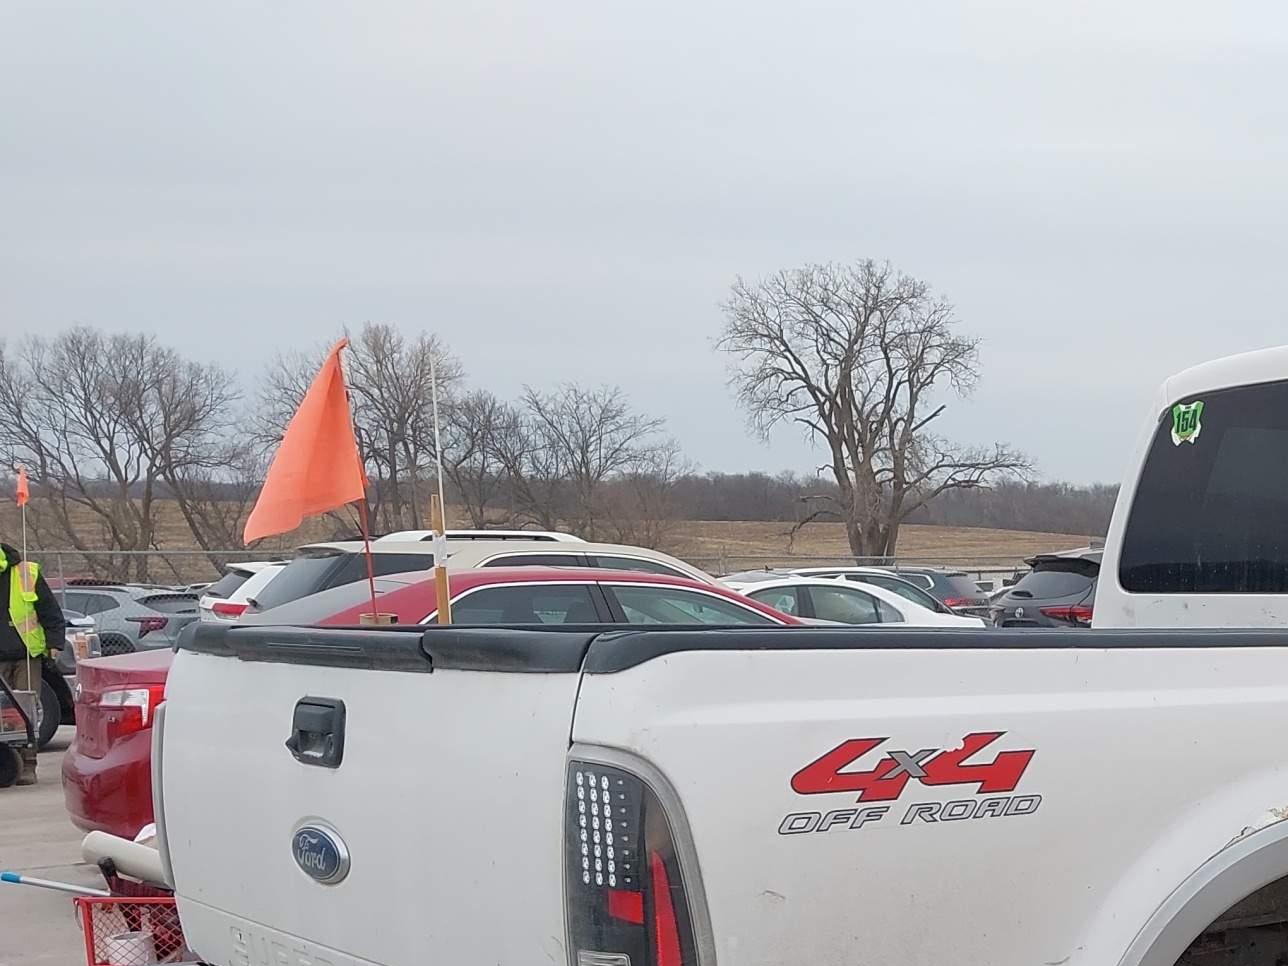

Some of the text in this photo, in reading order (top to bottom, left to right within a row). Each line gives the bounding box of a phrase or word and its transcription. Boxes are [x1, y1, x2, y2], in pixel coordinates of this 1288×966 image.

[1175, 409, 1198, 433] 154
[778, 794, 1043, 835] OFF ROAD
[297, 833, 328, 871] Ford
